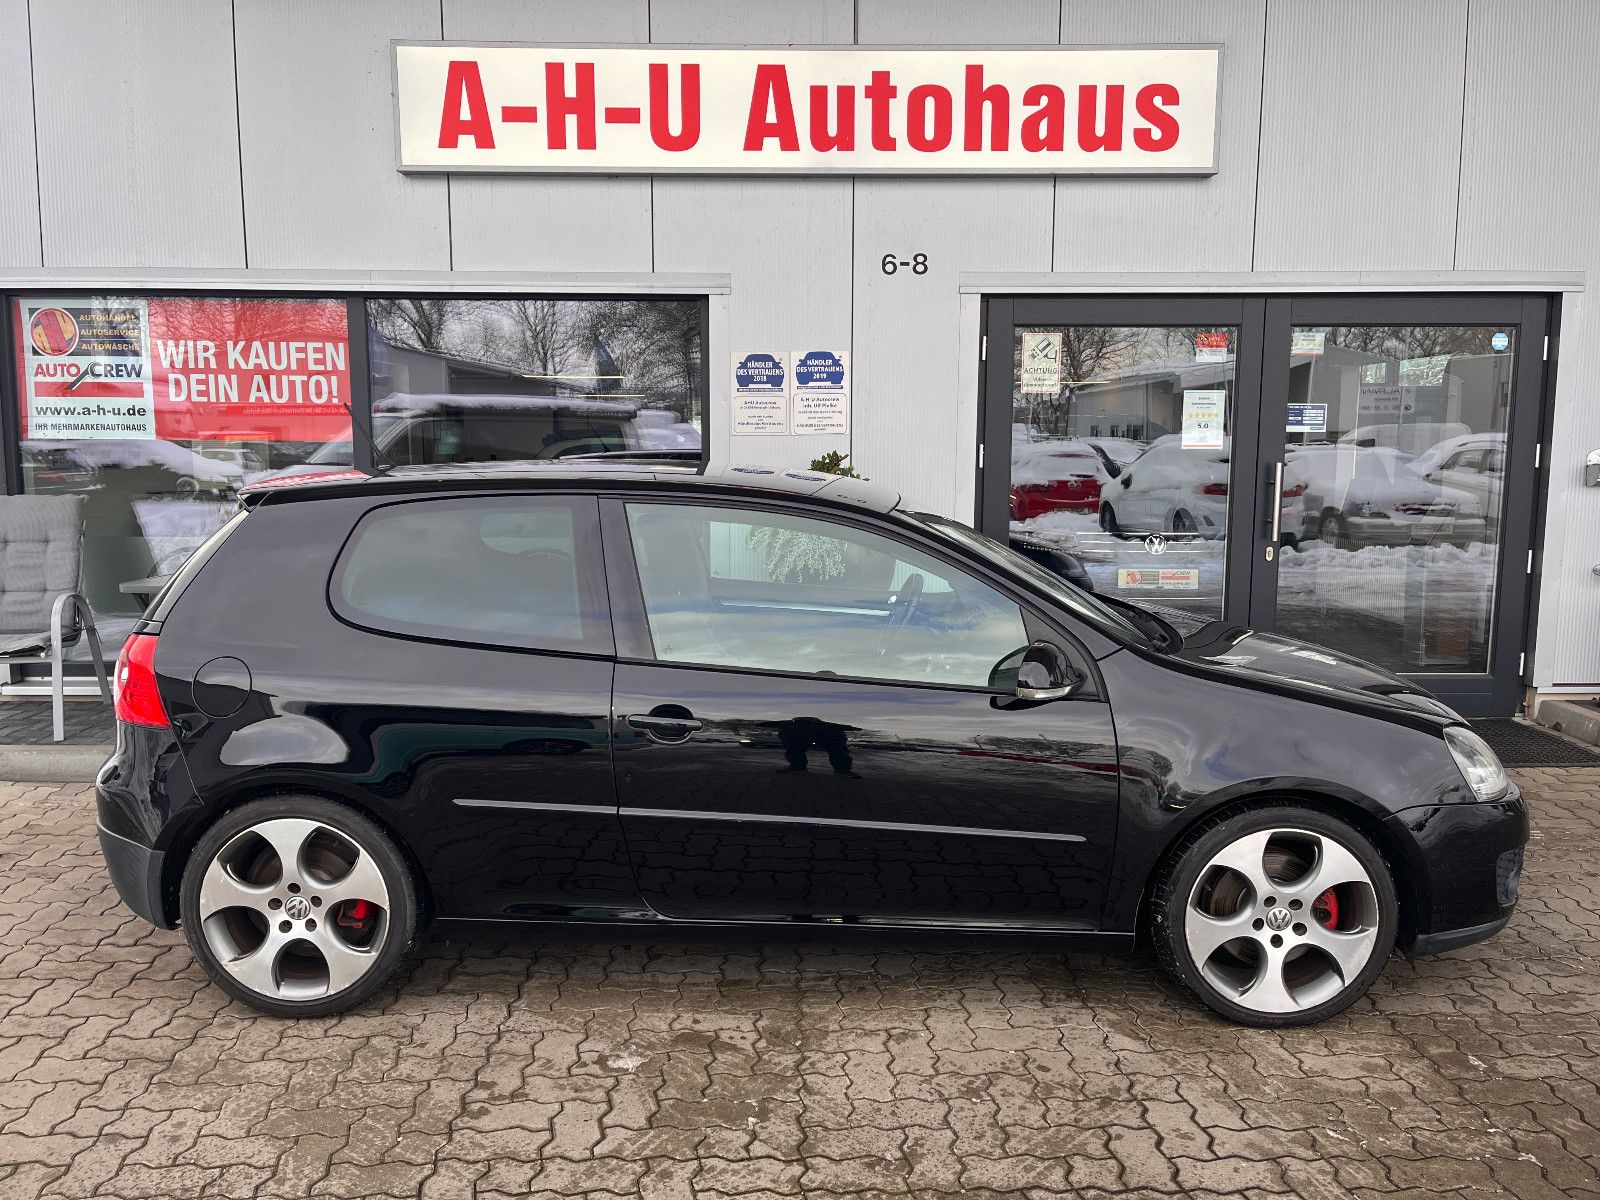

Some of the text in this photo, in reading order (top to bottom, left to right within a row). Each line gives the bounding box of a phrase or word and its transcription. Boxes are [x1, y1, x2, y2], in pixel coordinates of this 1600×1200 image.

[438, 61, 1180, 153] A-H-U Autohaus
[881, 253, 928, 275] 6-8
[81, 328, 139, 336] AUTOSERVICE
[156, 339, 346, 371] WIR KAUFEN
[34, 362, 143, 378] AUTO CREW
[748, 368, 784, 376] VERTRAUENS
[168, 373, 339, 404] DEIN AUTO!
[35, 405, 147, 416] www.a-h-u.de
[35, 423, 147, 431] IHR MEHRMARKENAUTOHAUS
